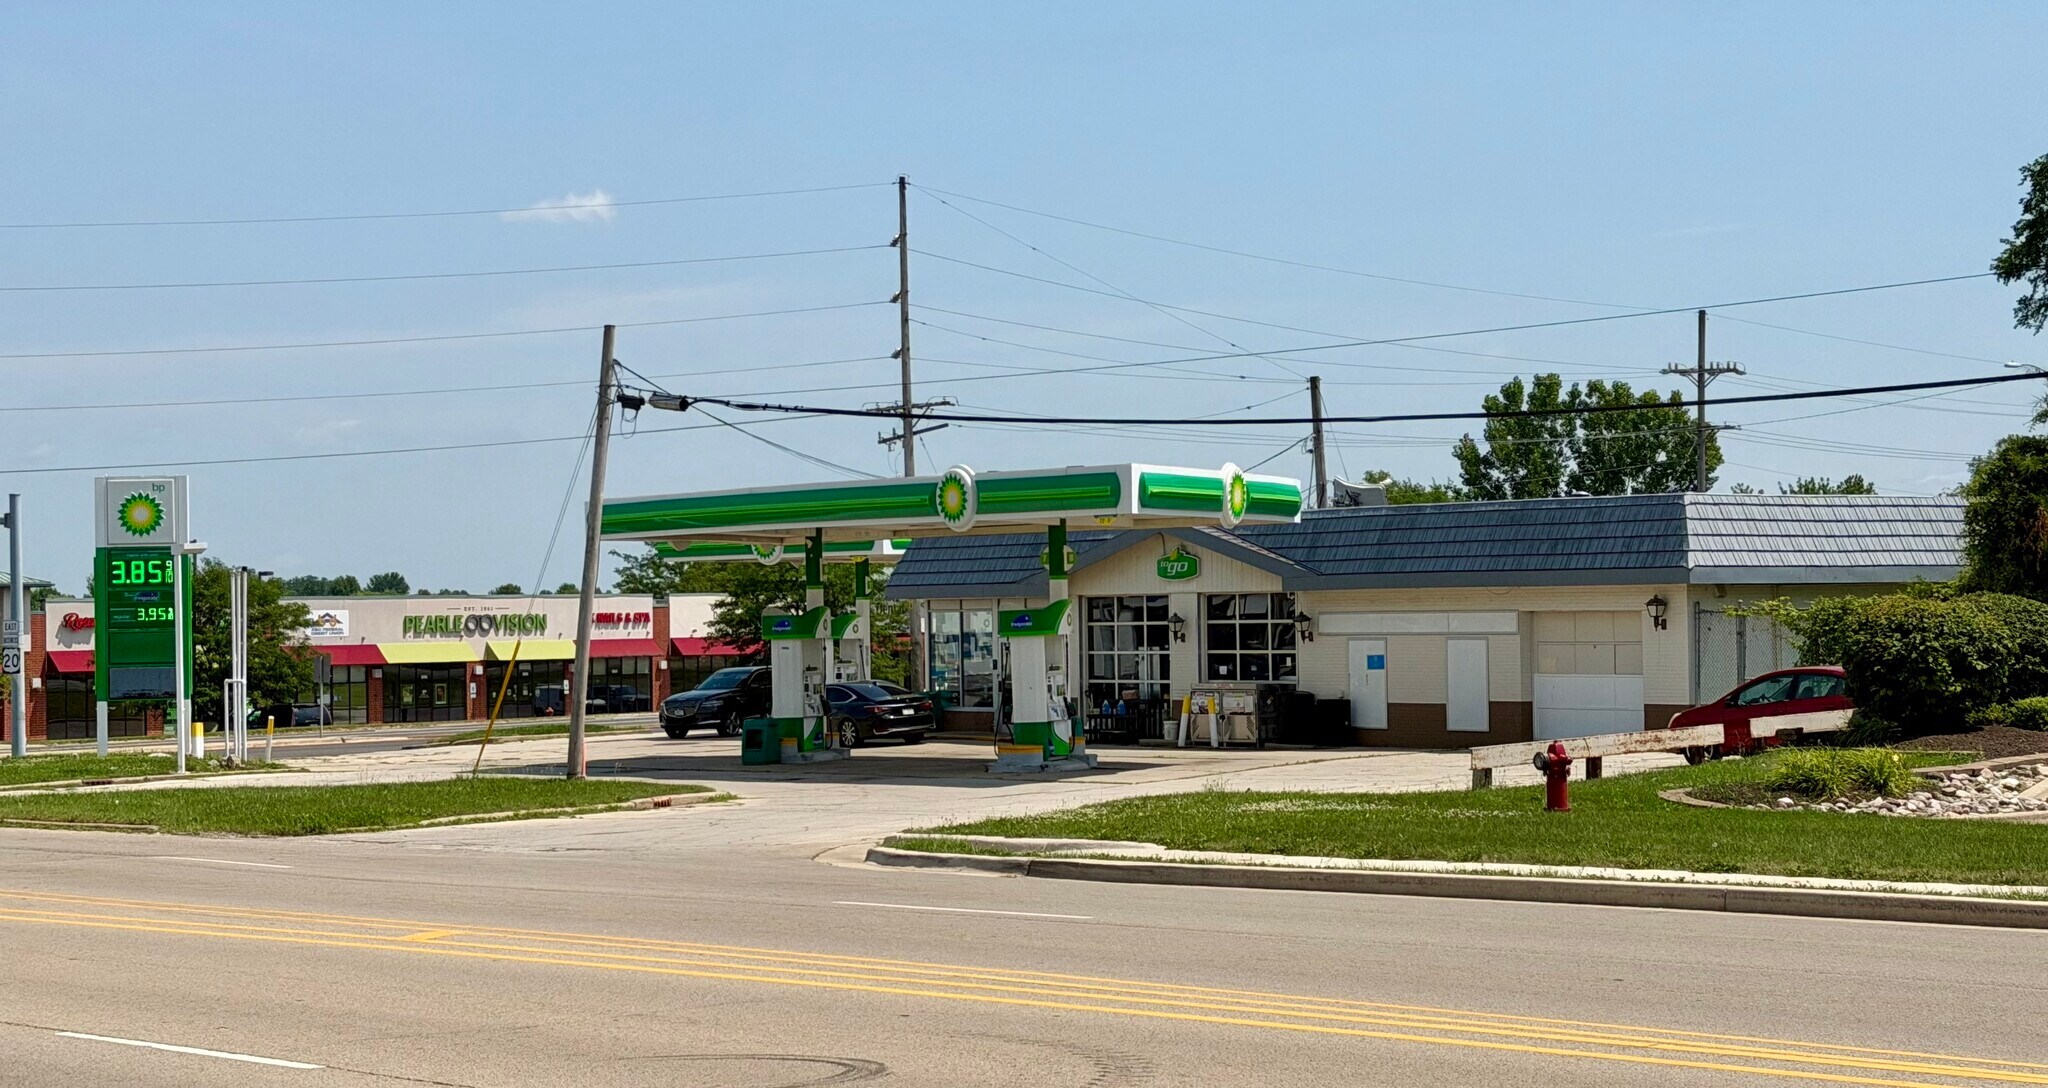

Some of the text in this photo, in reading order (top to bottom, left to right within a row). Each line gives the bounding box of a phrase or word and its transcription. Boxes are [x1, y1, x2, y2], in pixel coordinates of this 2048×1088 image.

[152, 483, 166, 493] bp
[112, 561, 162, 584] 3.85
[1167, 561, 1189, 576] go
[137, 607, 167, 621] 3.95
[596, 612, 623, 624] NAILS
[624, 612, 632, 623] &
[633, 612, 651, 623] SPA
[4, 622, 17, 631] EAST
[403, 613, 548, 634] PEARLE VISION
[4, 653, 19, 668] 20
